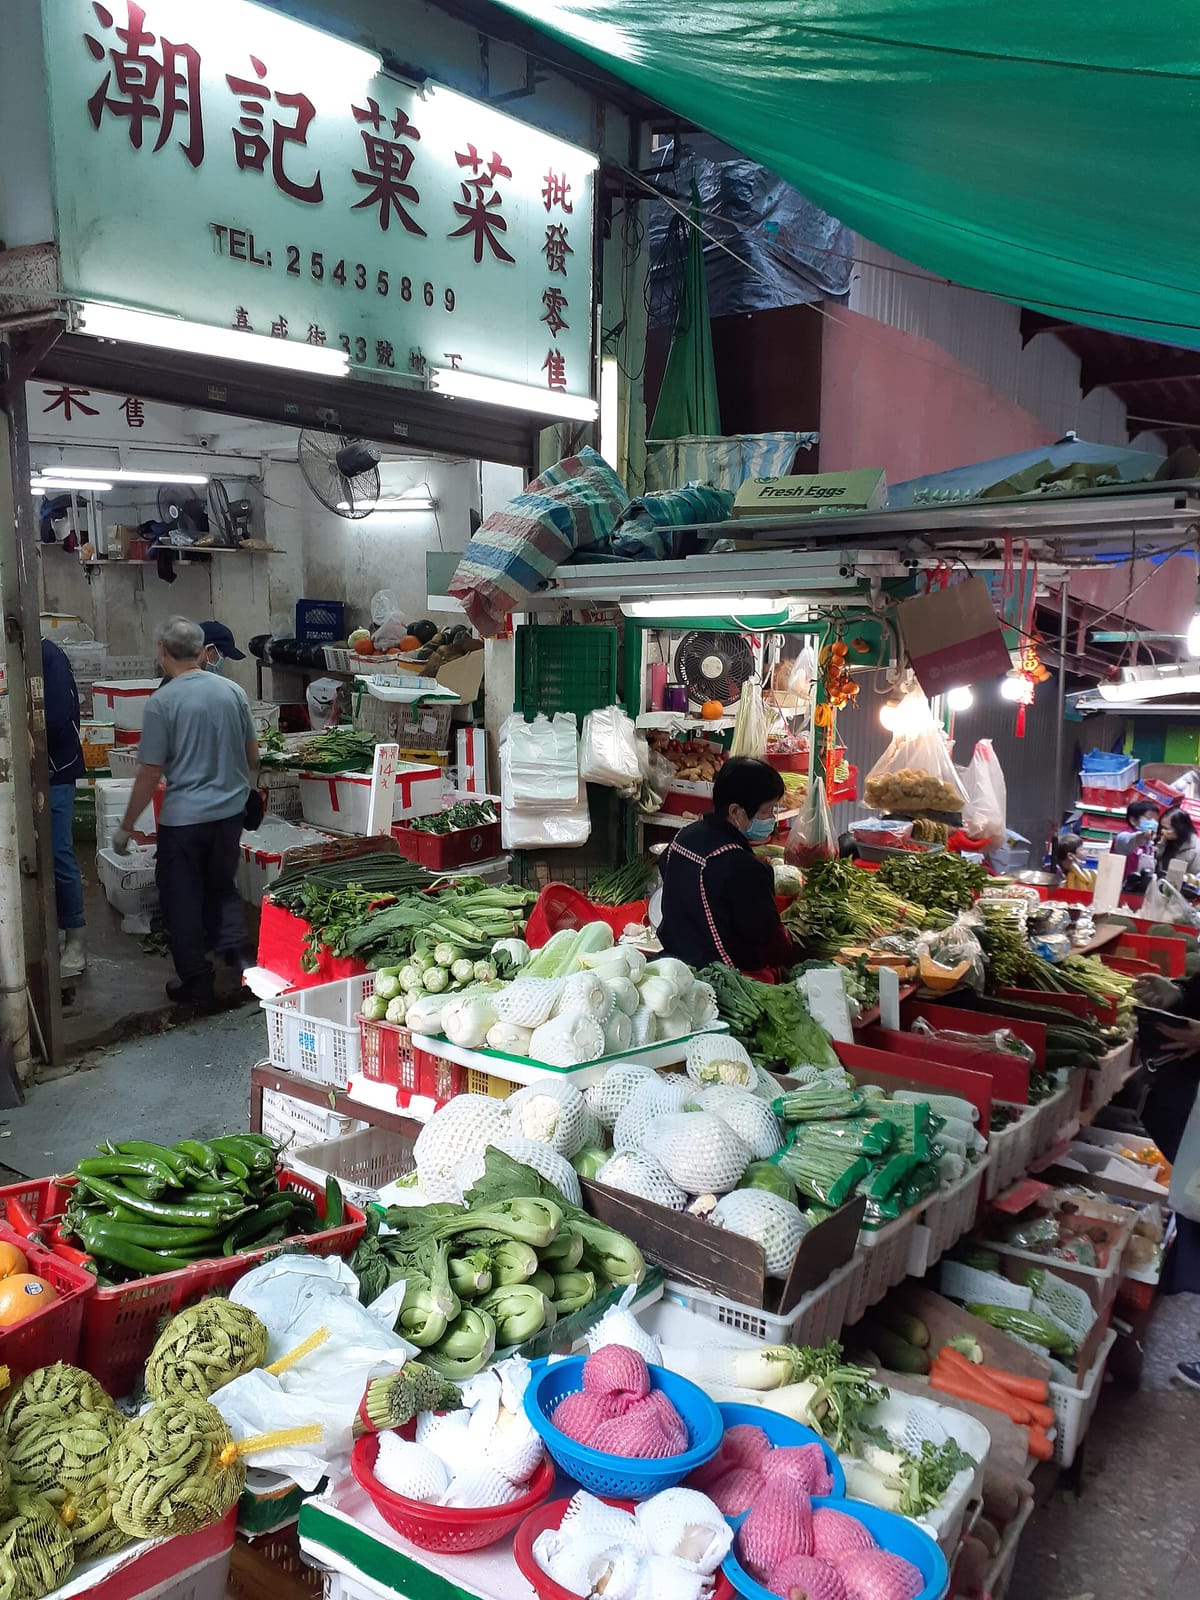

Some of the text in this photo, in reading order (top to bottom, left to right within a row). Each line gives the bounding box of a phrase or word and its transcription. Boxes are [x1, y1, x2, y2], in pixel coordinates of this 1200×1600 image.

[83, 0, 516, 265] 潮記菓菜
[210, 222, 456, 313] TEL: 25435869
[541, 168, 575, 394] 批發零售
[758, 485, 847, 498] Fresh Eggs
